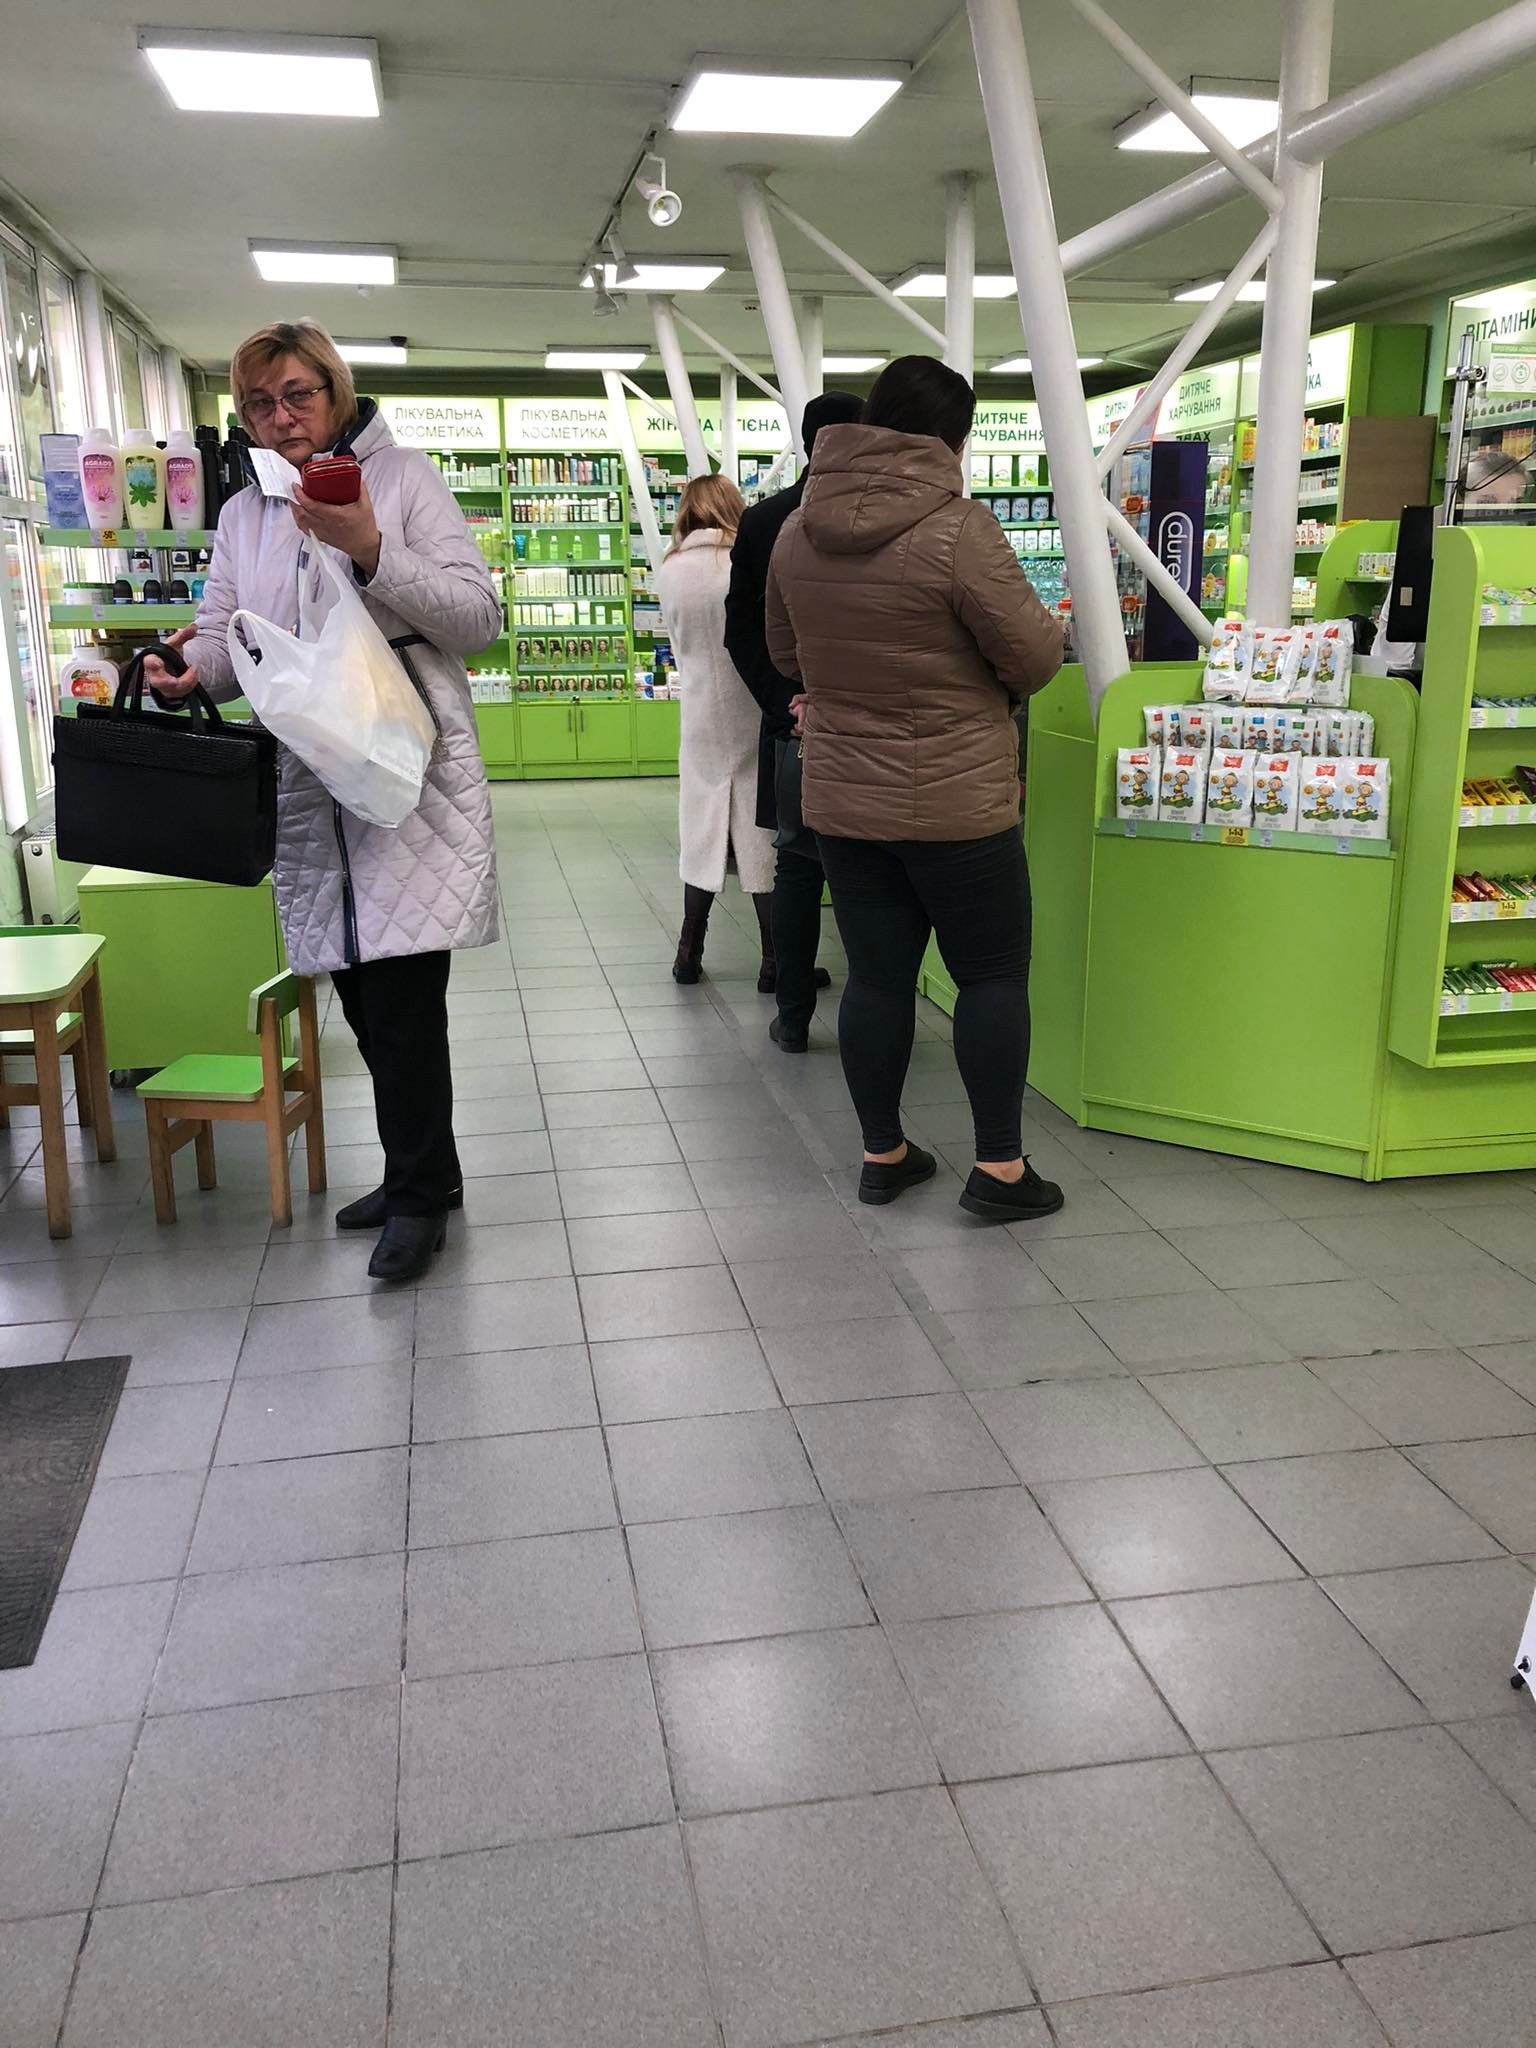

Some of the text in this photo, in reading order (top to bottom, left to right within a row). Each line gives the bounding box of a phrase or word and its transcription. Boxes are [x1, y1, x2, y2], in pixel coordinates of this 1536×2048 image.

[1179, 379, 1211, 402] ДИТЯЧЕ
[395, 407, 483, 420] ЛІКУВАЛЬНА
[521, 409, 607, 421] ЛІКУВАЛЬНА
[1168, 397, 1222, 420] ХАРЧУВАННЯ
[647, 418, 781, 432] ЖІНА ІЄНА
[972, 412, 1028, 426] ДИТЯЧЕ
[396, 426, 484, 438] КОСМЕТИКА
[522, 427, 608, 439] КОСМЕТИКА
[971, 429, 1045, 441] ЧУВАННЯ
[1167, 521, 1188, 584] dure
